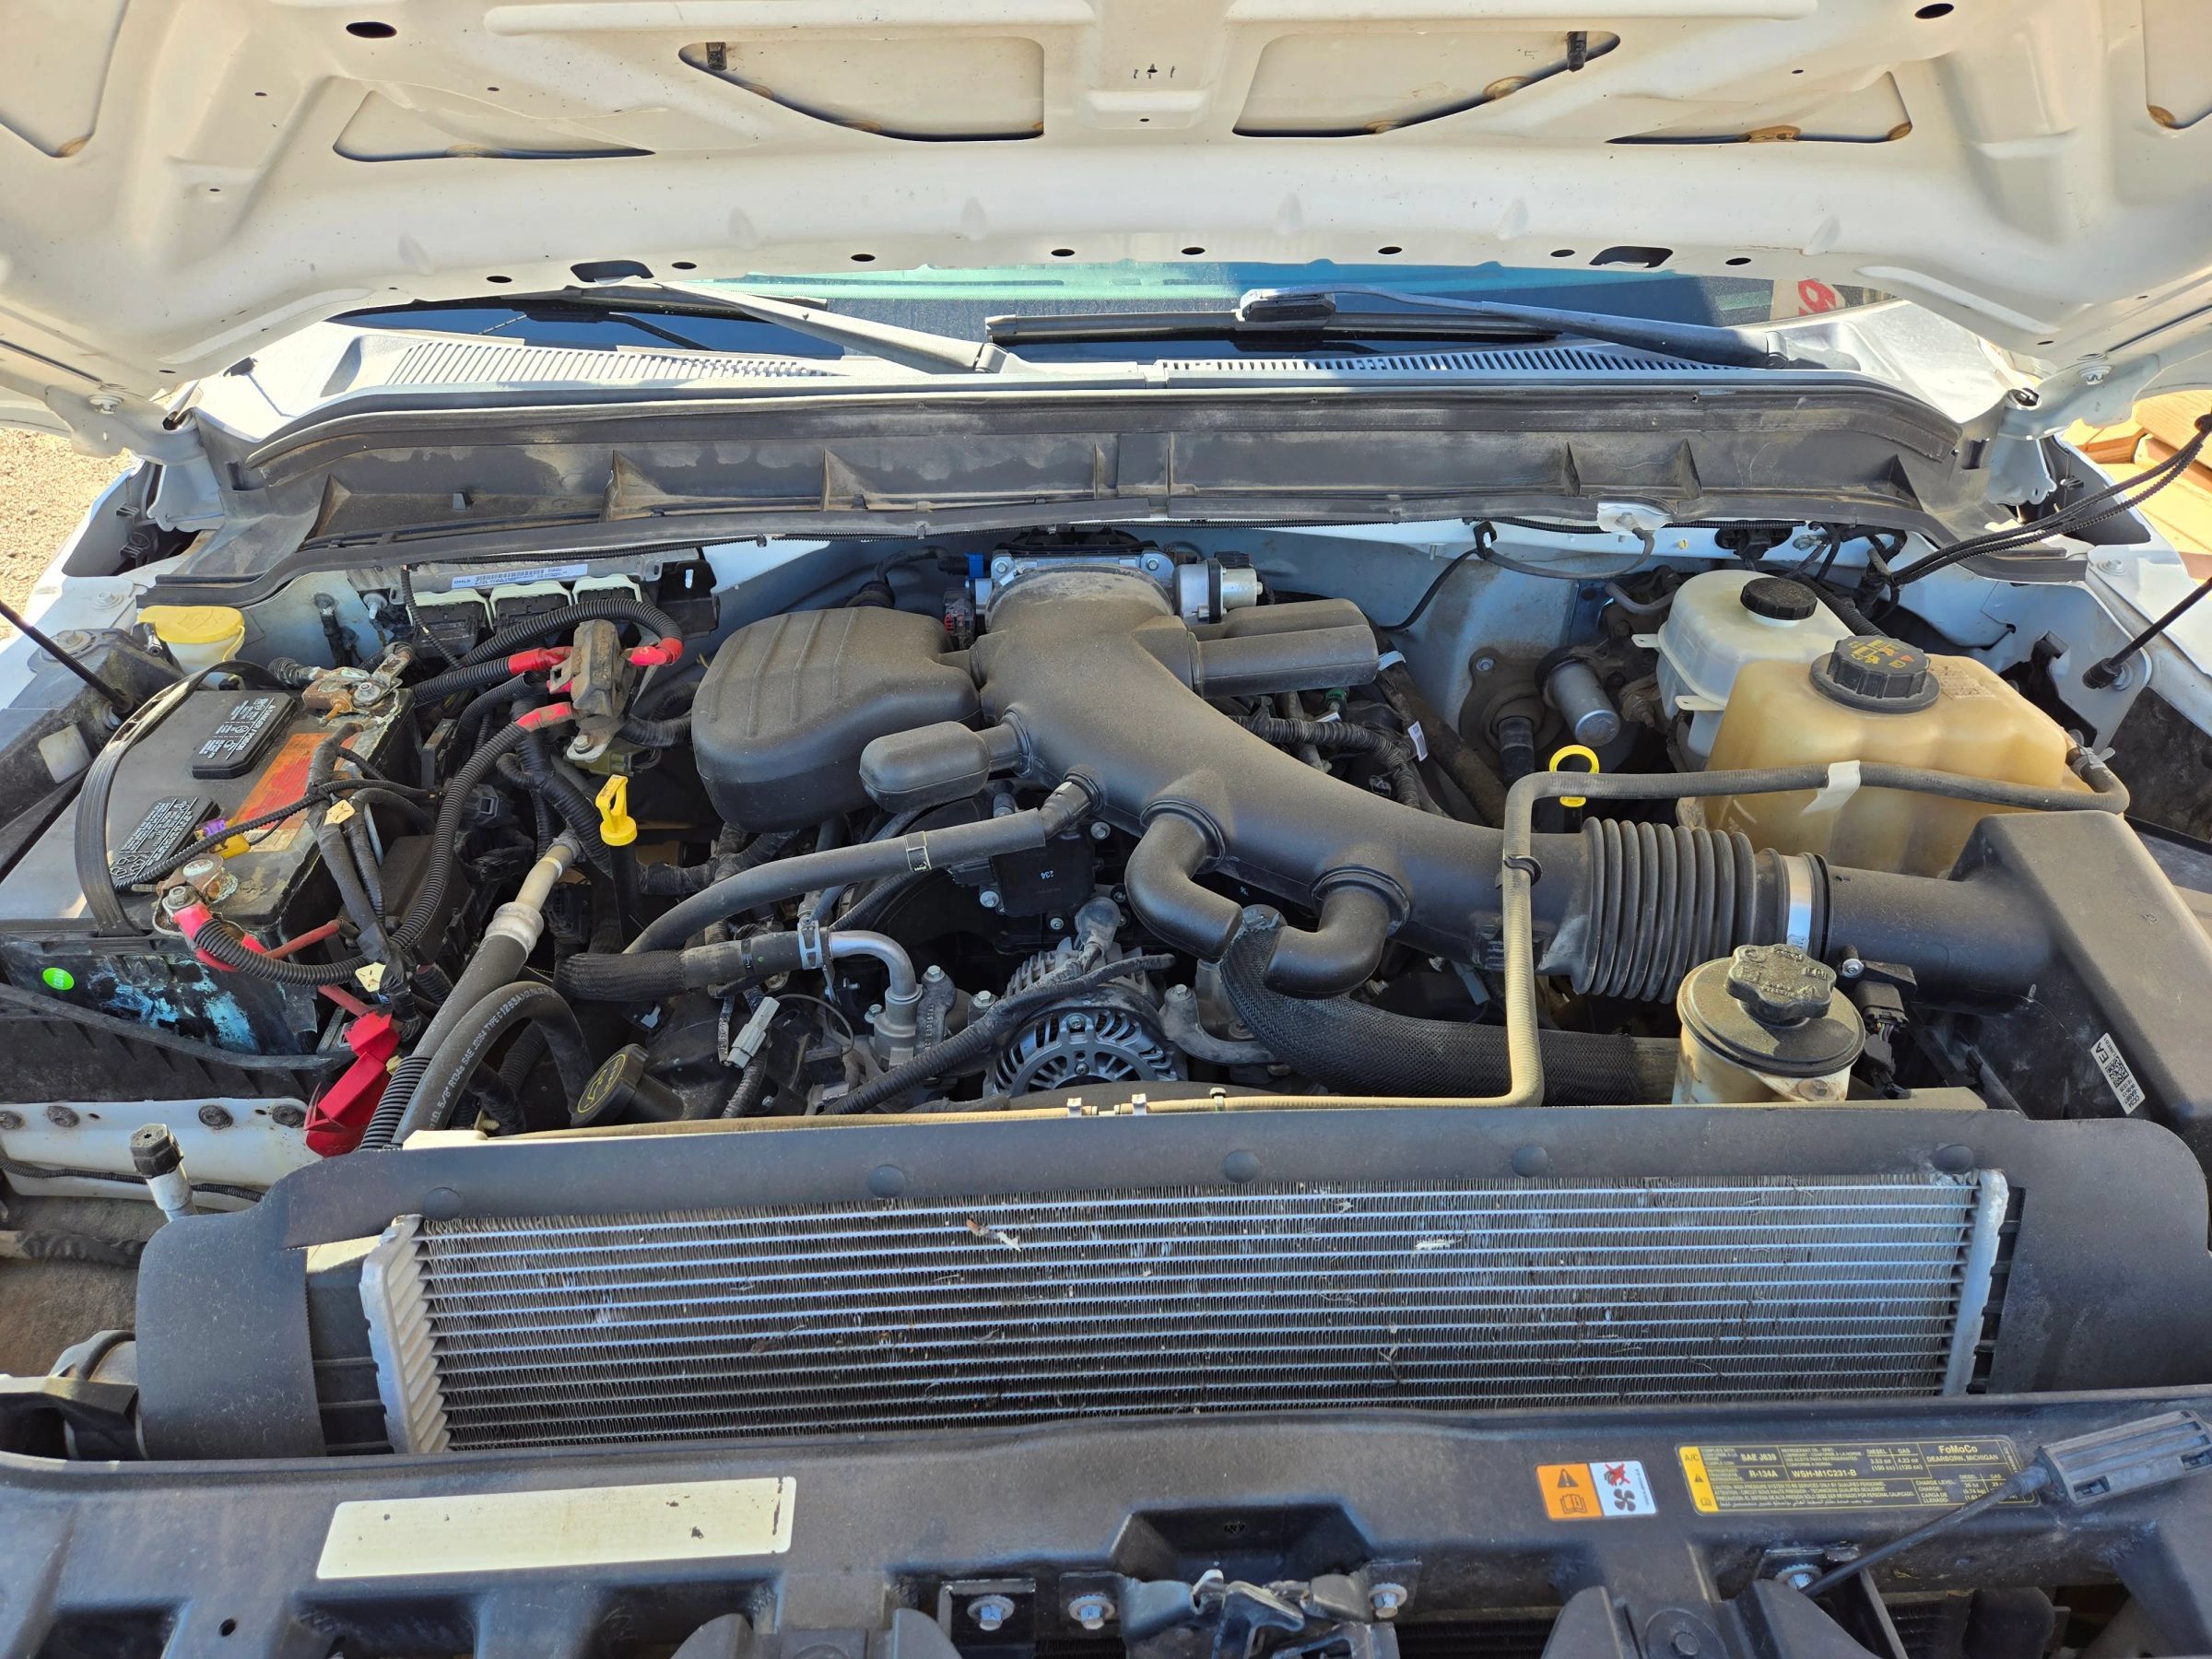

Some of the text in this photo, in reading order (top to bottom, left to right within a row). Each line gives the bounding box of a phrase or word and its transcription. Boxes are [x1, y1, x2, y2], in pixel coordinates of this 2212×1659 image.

[448, 1065, 465, 1088] R134a
[461, 1048, 475, 1065] SAE
[484, 1015, 500, 1030] TYPE
[2095, 1041, 2110, 1064] EA
[1938, 1444, 1978, 1453] FoMoCo
[1740, 1453, 1757, 1462] SAE
[1926, 1454, 1966, 1463] DEARBORN,
[1748, 1469, 1778, 1478] R-134A
